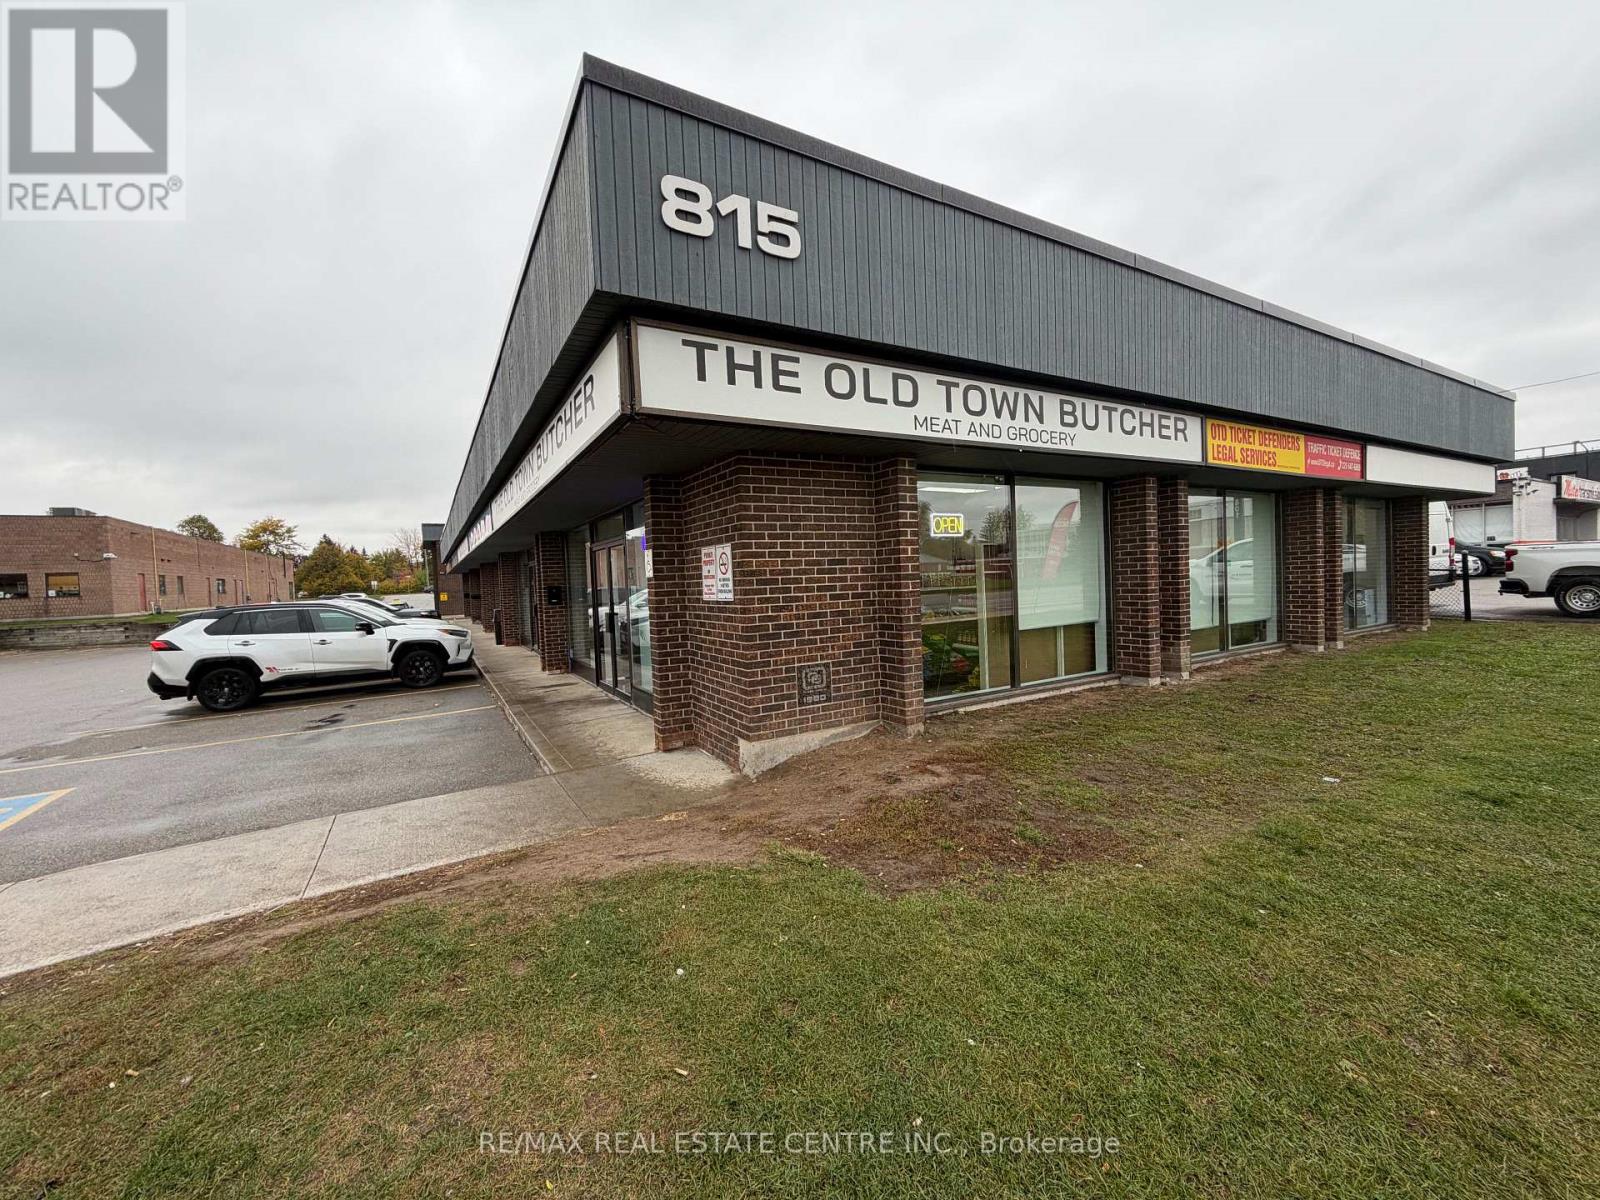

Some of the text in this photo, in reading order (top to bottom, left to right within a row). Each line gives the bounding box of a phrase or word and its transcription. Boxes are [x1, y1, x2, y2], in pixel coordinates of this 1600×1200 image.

[660, 174, 802, 260] 815
[681, 338, 1189, 443] THE OLD TOWN BUTCHER
[536, 373, 596, 474] BUTCHER
[913, 414, 1077, 447] MEAT AND GROCERY
[1210, 422, 1301, 451] OTD TICKET DEFENDERS
[1212, 444, 1277, 468] LEGAL SERVICES
[1307, 441, 1327, 456] TRAFFIC
[1327, 445, 1342, 457] TICKET
[933, 517, 963, 534] OPEN
